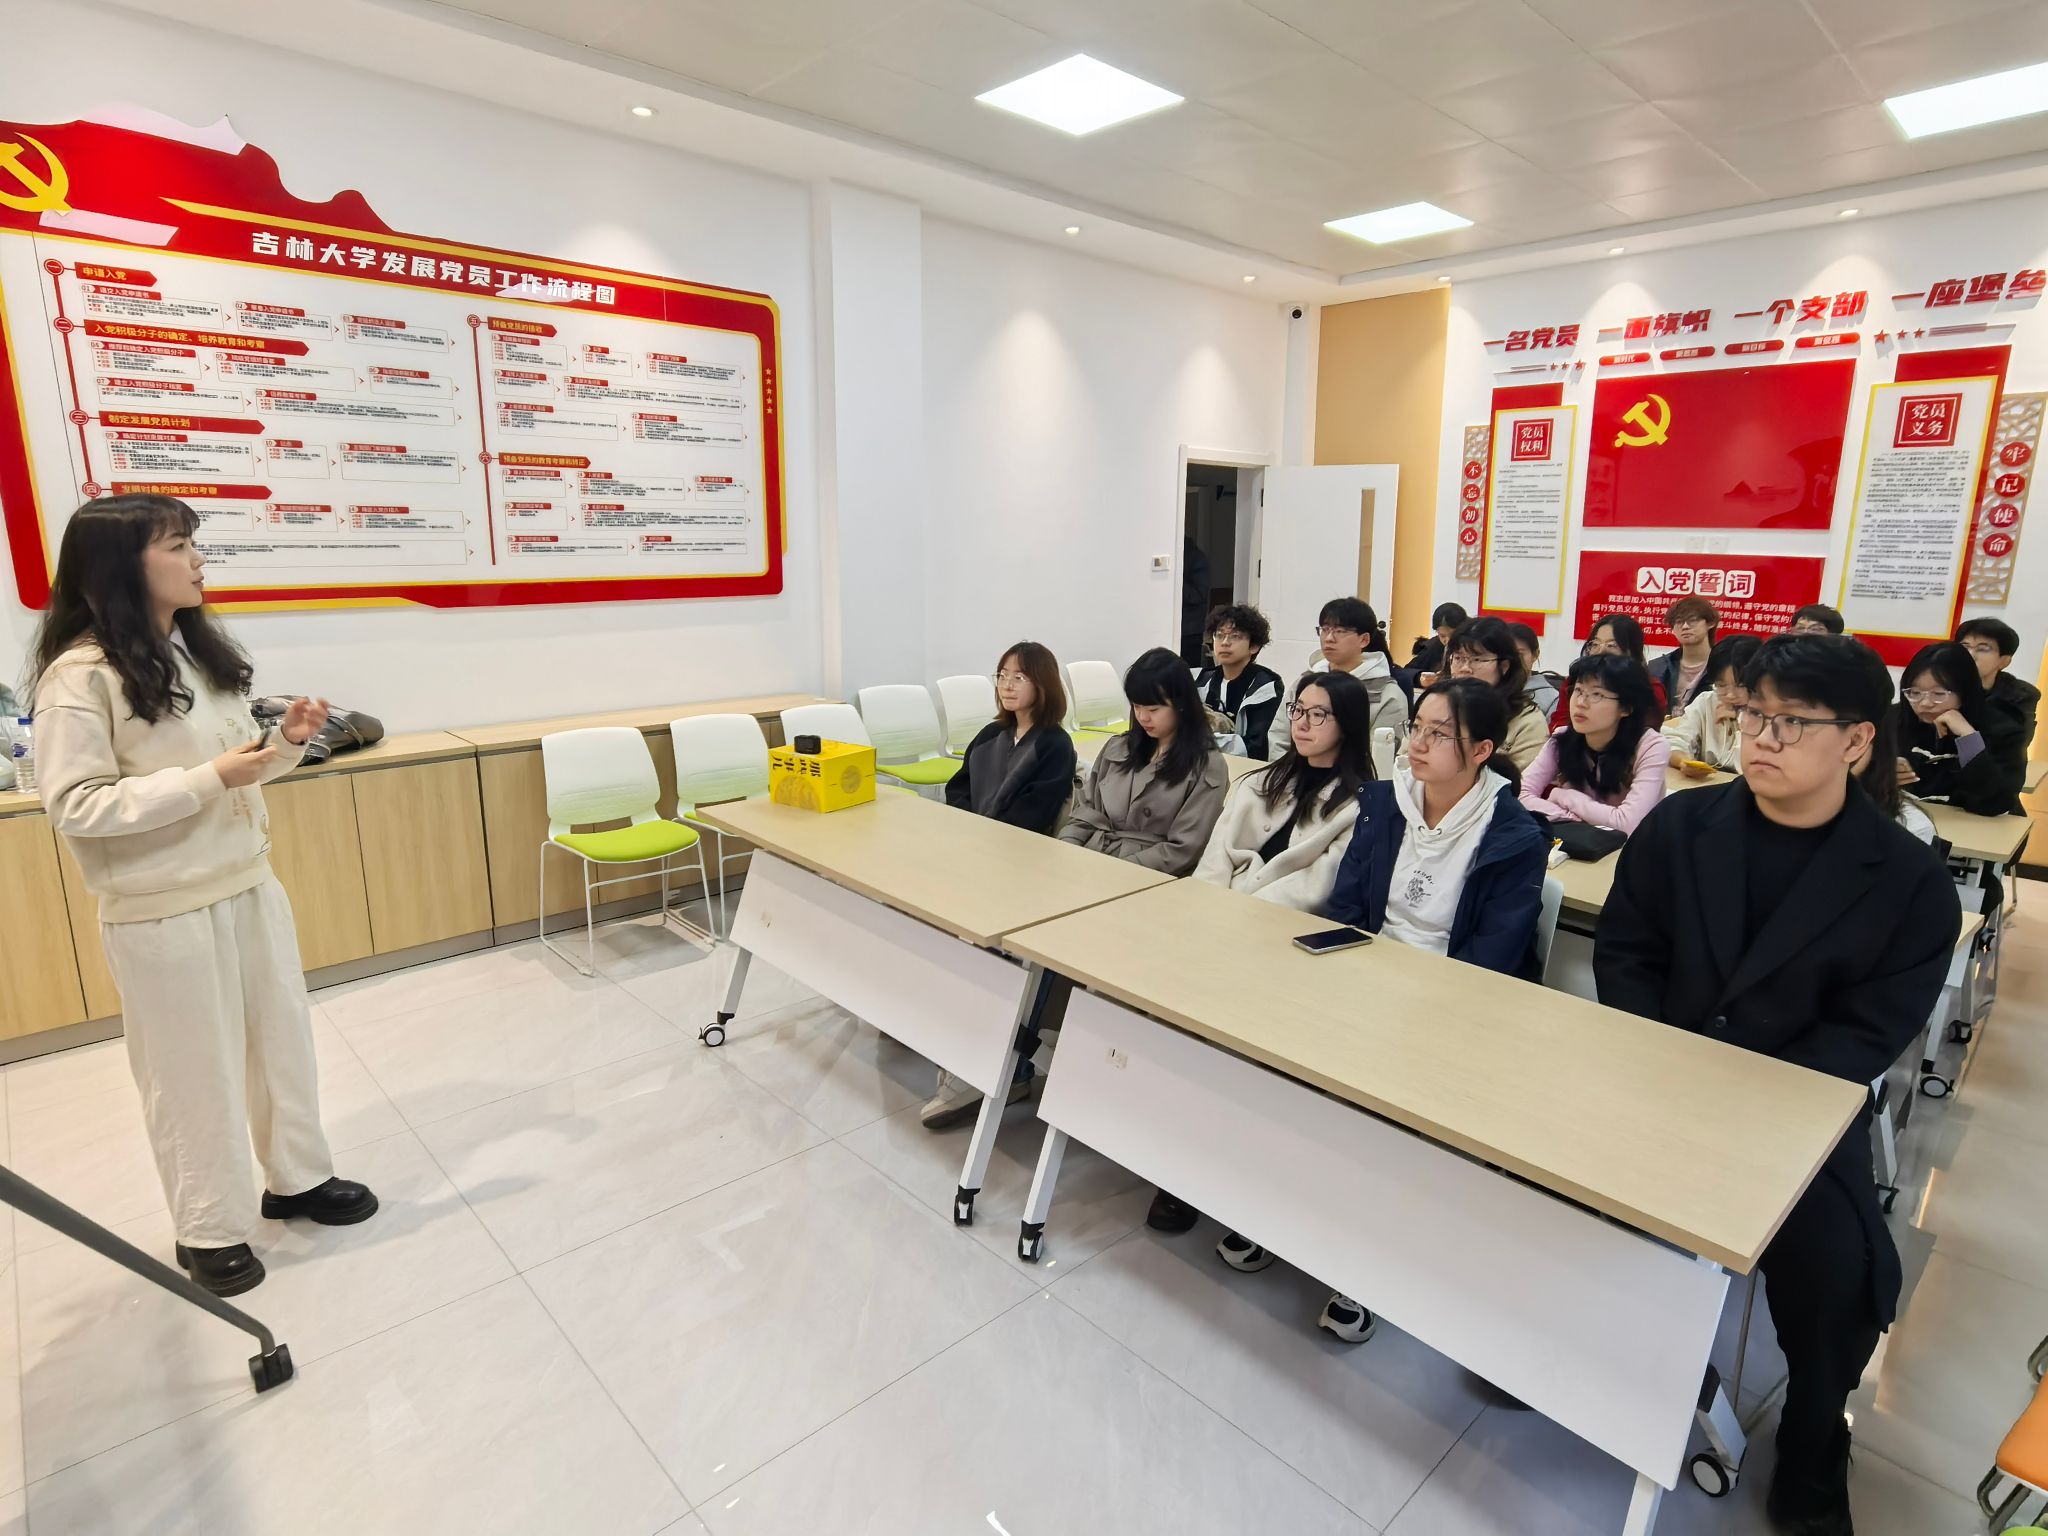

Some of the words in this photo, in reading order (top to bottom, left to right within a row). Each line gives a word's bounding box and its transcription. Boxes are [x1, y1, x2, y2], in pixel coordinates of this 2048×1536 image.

[82, 267, 127, 280] 申请入党
[252, 232, 615, 305] 吉林大学发展党员工作流程图
[1892, 269, 2047, 308] 一座堡垒
[1734, 290, 1867, 324] 一个支部
[1599, 308, 1711, 339] 一面旗帜
[95, 324, 265, 349] 入党积极分子的确定、培养教育和考察
[1483, 324, 1580, 351] 一名党员
[108, 414, 190, 428] 制定发展党员计划
[1911, 403, 1946, 420] 党员
[1520, 426, 1544, 438] 党员
[1908, 420, 1944, 436] 义务
[1520, 439, 1543, 452] 权利
[1463, 464, 1480, 543] 不忘初心
[1988, 446, 2026, 553] 牢记使命
[1639, 571, 1754, 595] 入党誓词
